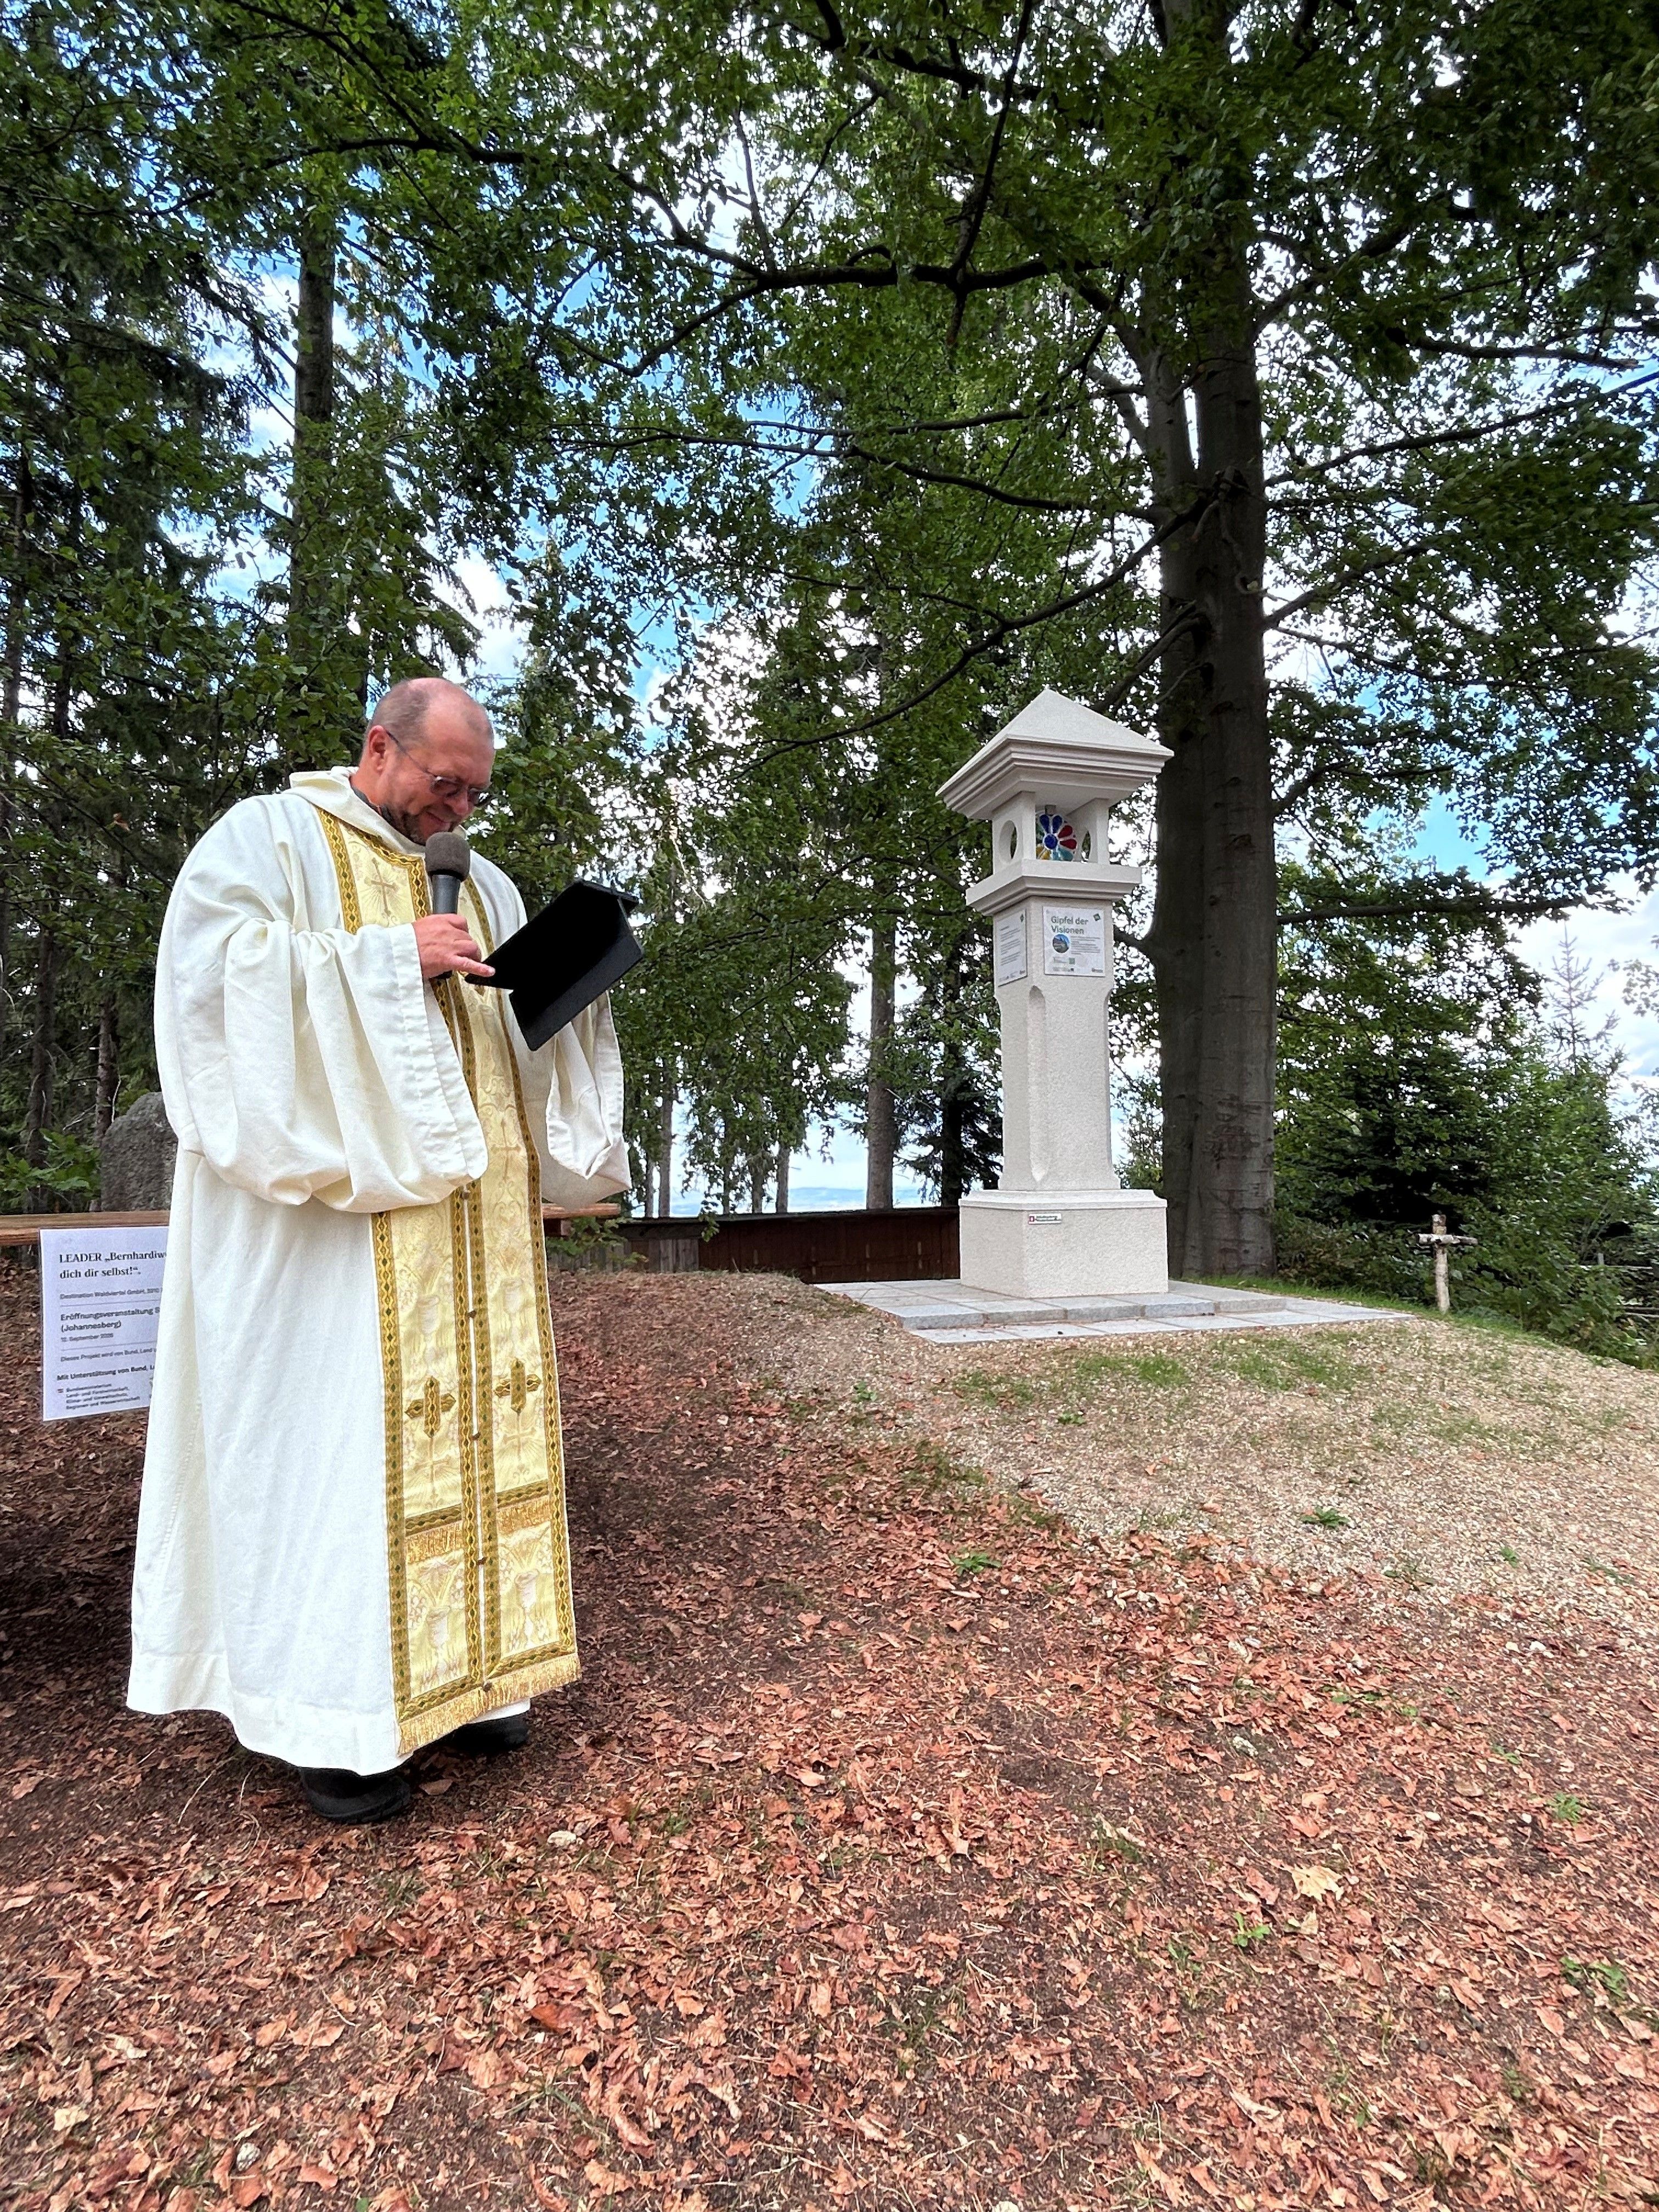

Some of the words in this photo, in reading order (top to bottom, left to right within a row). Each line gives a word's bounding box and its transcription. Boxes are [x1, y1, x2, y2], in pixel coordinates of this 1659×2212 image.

[1051, 916, 1074, 925] Gipfel
[1051, 925, 1085, 934] Visionen
[59, 1252, 102, 1263] LEADER
[60, 1269, 81, 1279] dich
[84, 1268, 99, 1277] dir
